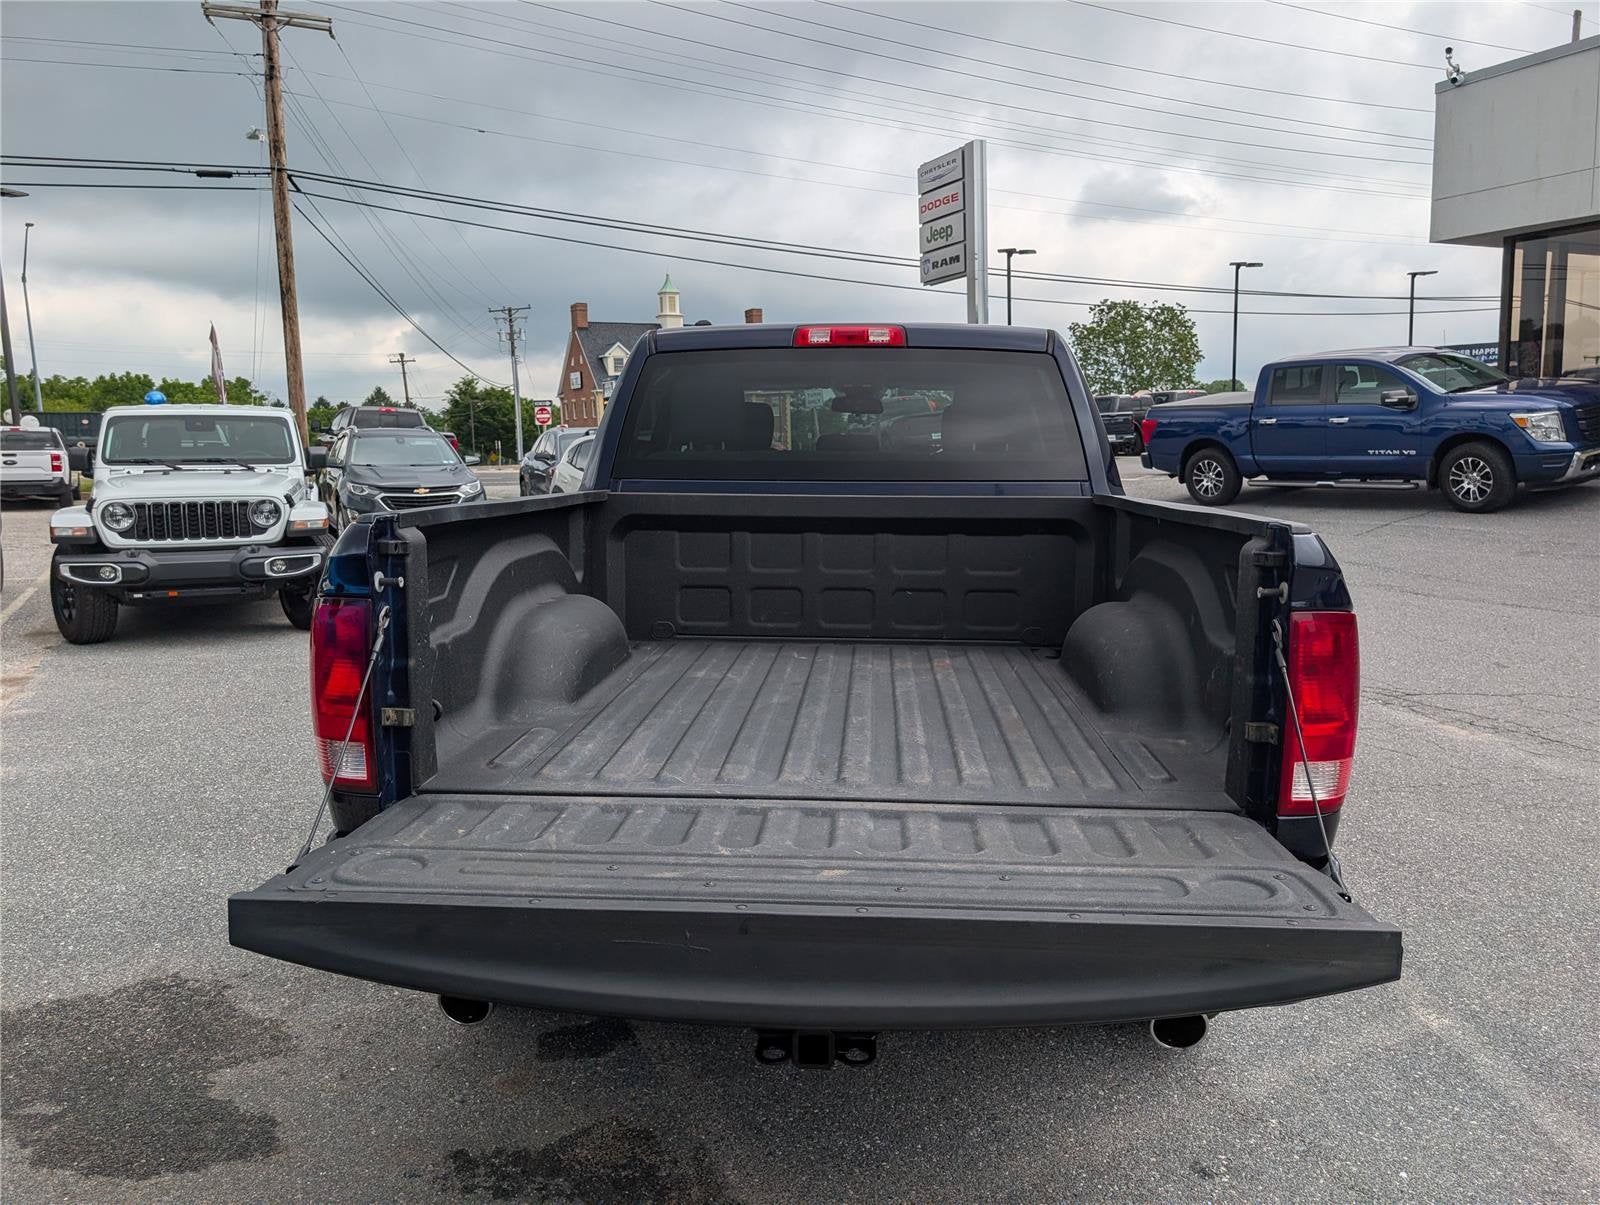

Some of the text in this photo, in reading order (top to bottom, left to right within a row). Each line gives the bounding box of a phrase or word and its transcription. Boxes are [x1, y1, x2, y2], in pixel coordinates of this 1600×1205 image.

[920, 158, 957, 177] CHRYSLER
[920, 192, 959, 214] DODGE
[926, 224, 953, 244] Jeep
[931, 254, 960, 270] RAM
